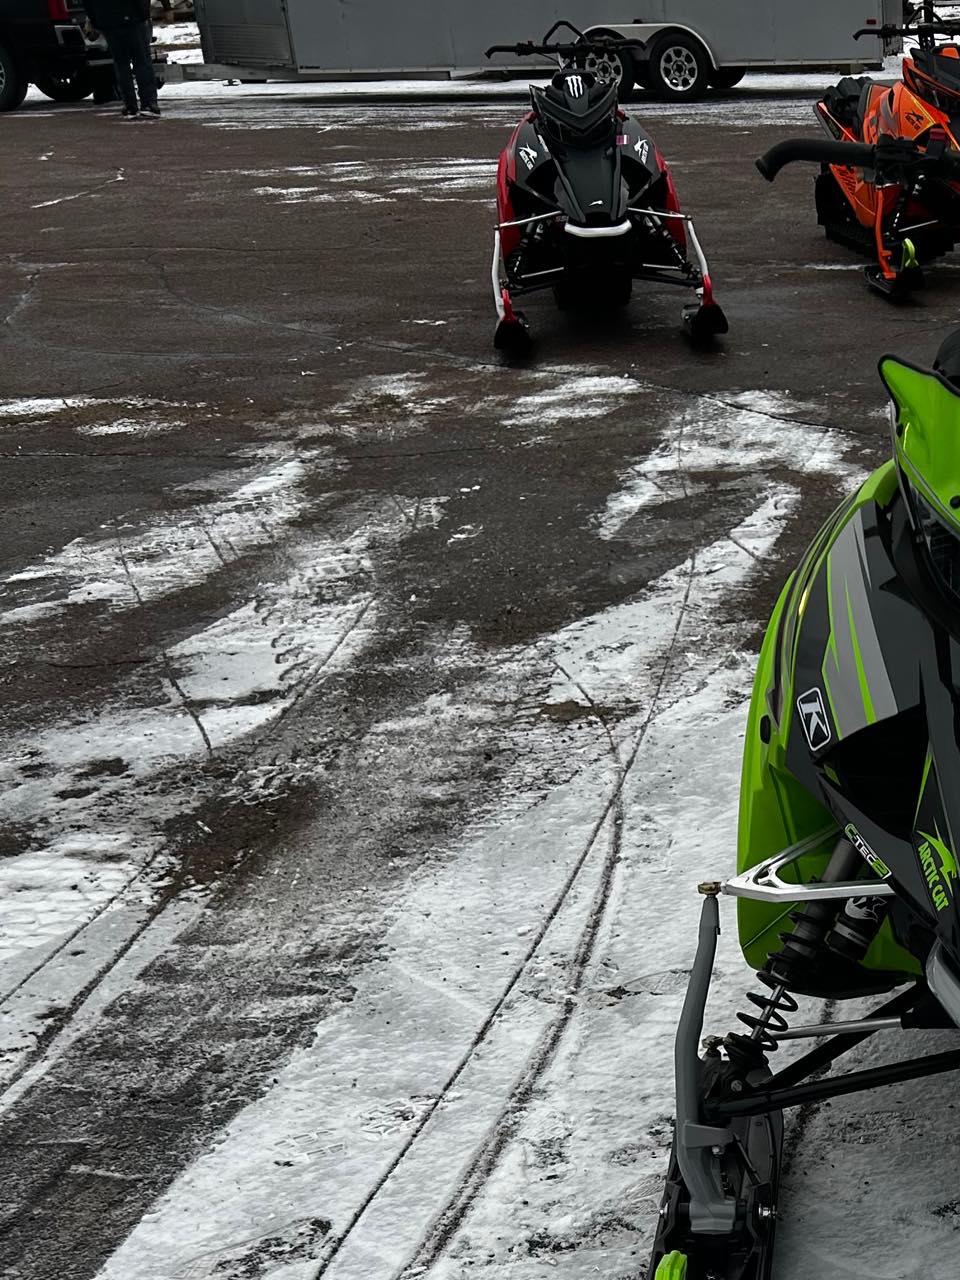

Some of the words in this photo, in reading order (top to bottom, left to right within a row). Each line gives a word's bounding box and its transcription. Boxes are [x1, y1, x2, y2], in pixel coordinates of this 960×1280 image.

[799, 696, 828, 742] K
[845, 824, 892, 879] C-TEC2
[918, 841, 940, 889] ARCTIC
[932, 884, 949, 912] CAT
